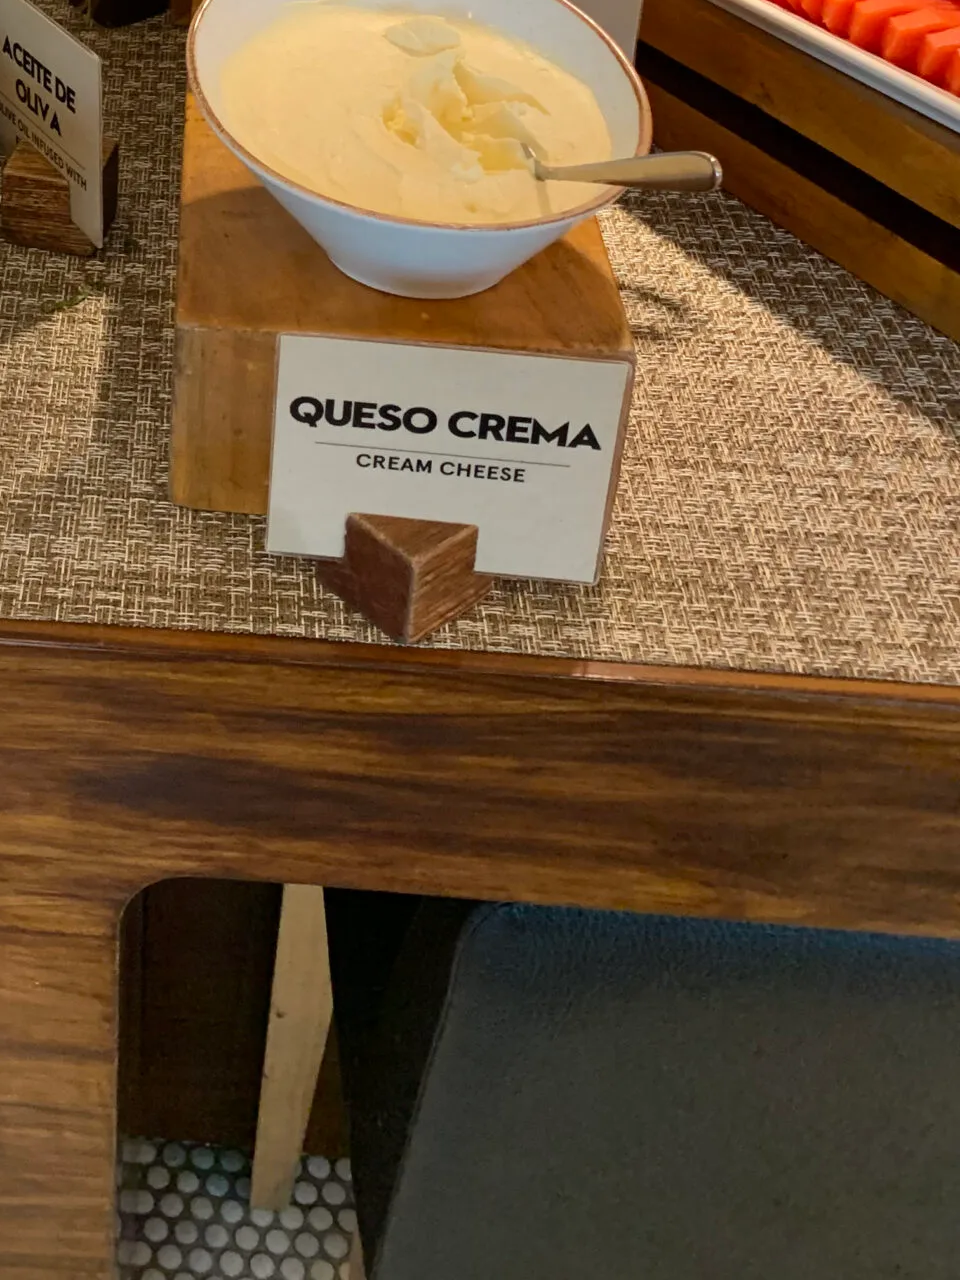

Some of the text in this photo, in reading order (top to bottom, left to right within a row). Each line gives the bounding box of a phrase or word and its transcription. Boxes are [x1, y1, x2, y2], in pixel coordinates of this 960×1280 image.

[2, 35, 76, 114] ACEITE DE
[15, 78, 62, 137] OLIVA
[17, 119, 31, 139] OIL
[65, 161, 88, 192] WITH
[290, 396, 601, 450] QUESO CREMA
[356, 453, 525, 482] CREAM CHEESE
